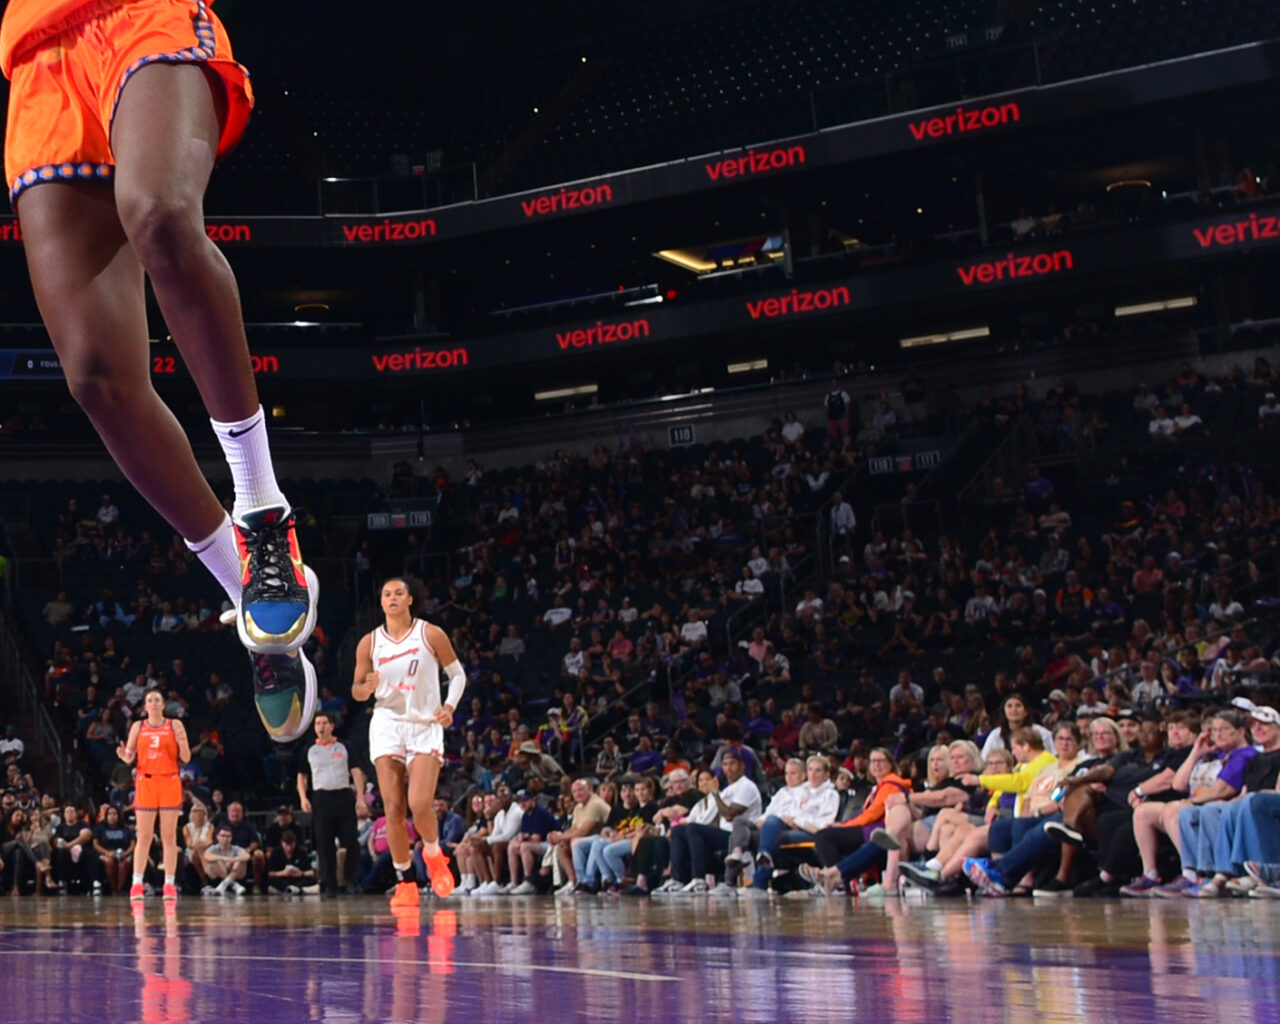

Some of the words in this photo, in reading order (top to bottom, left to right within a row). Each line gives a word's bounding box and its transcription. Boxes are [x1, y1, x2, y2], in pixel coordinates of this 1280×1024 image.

[909, 102, 1020, 140] verizon
[705, 145, 806, 181] verizon
[521, 183, 613, 217] verizon
[343, 218, 437, 242] verizon
[1193, 214, 1280, 248] veriz
[957, 249, 1074, 286] verizon
[746, 285, 851, 320] verizon
[556, 319, 650, 350] verizon
[40, 360, 62, 368] FOUL
[154, 356, 176, 373] 22
[372, 347, 469, 372] verizon
[407, 659, 419, 677] 0
[150, 735, 160, 749] 3
